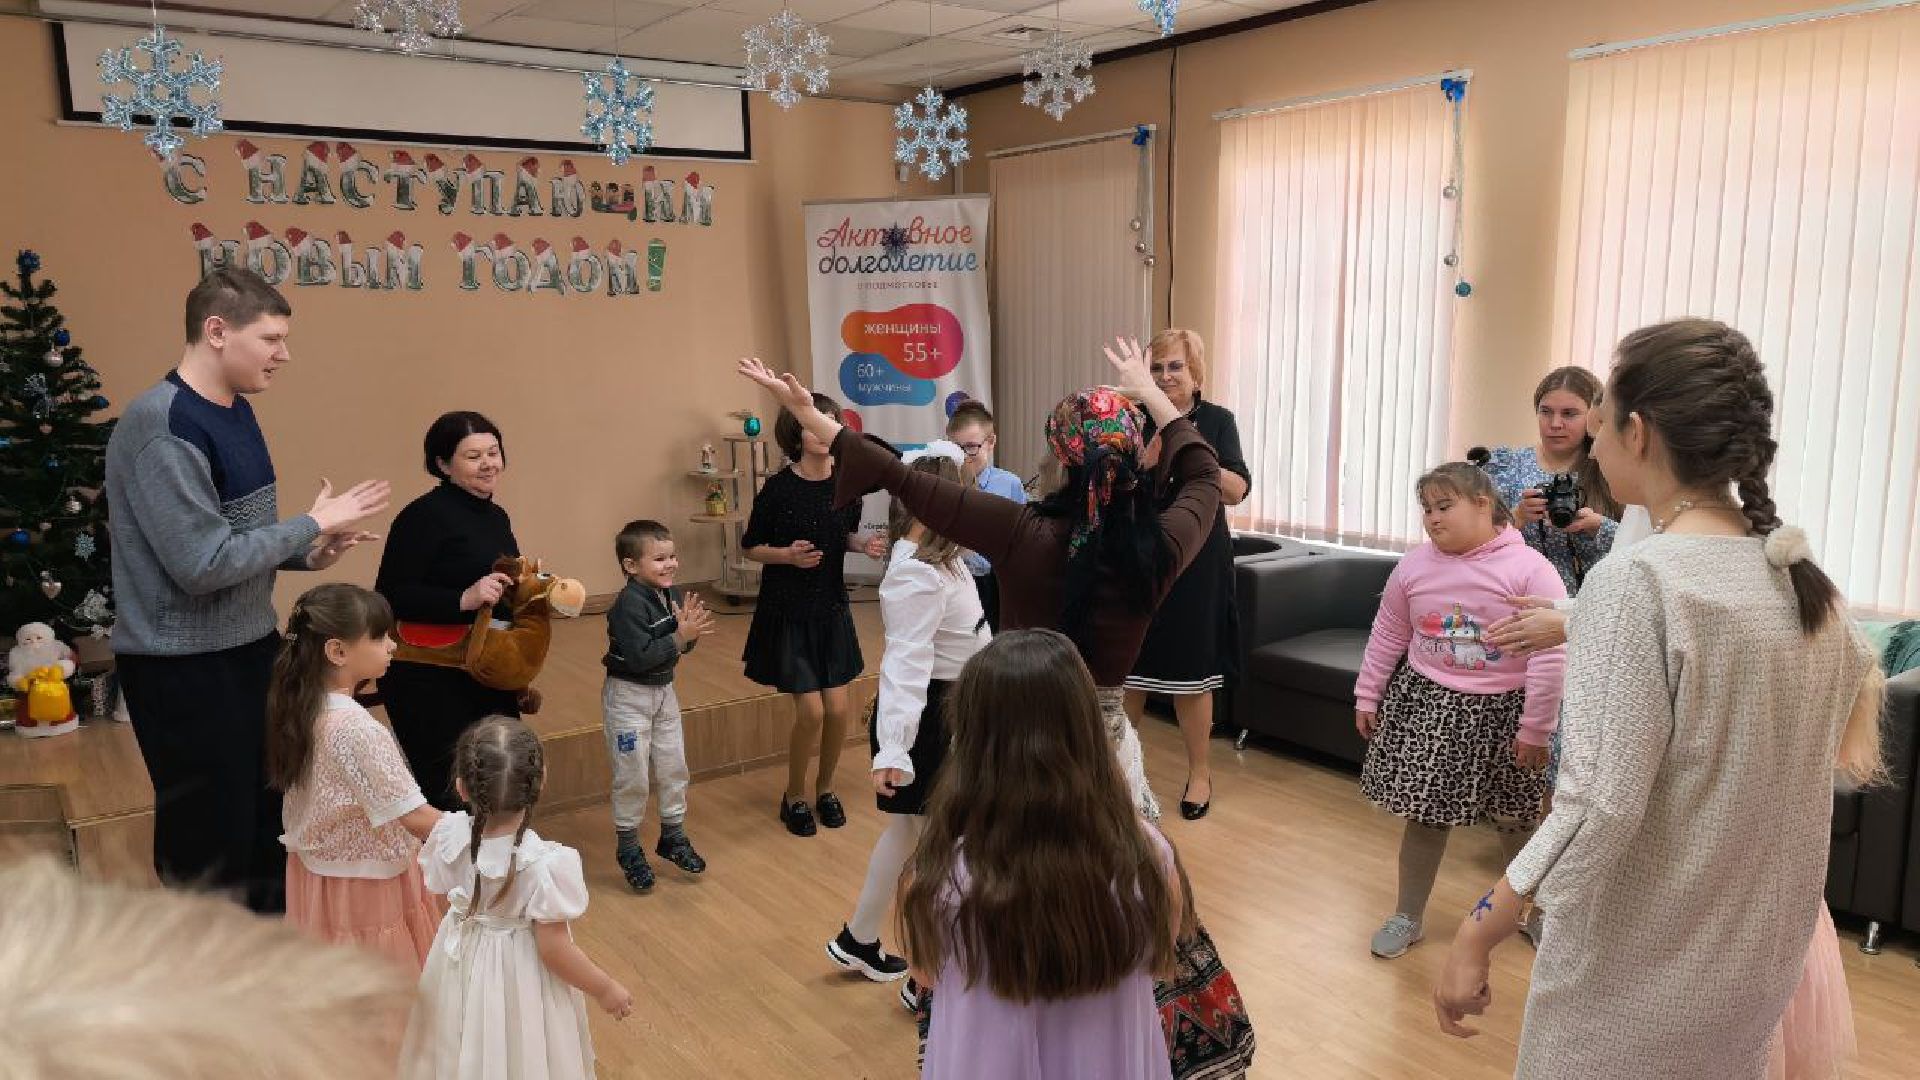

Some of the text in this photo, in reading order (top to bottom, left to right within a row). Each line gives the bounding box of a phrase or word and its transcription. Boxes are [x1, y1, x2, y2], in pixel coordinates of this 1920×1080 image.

[163, 150, 208, 206] С
[816, 215, 973, 248] Актвное
[453, 231, 667, 298] ГОДОМ!
[864, 323, 941, 337] женщины
[903, 342, 943, 363] 55+
[857, 363, 884, 378] 60+
[858, 382, 912, 395] мужчины
